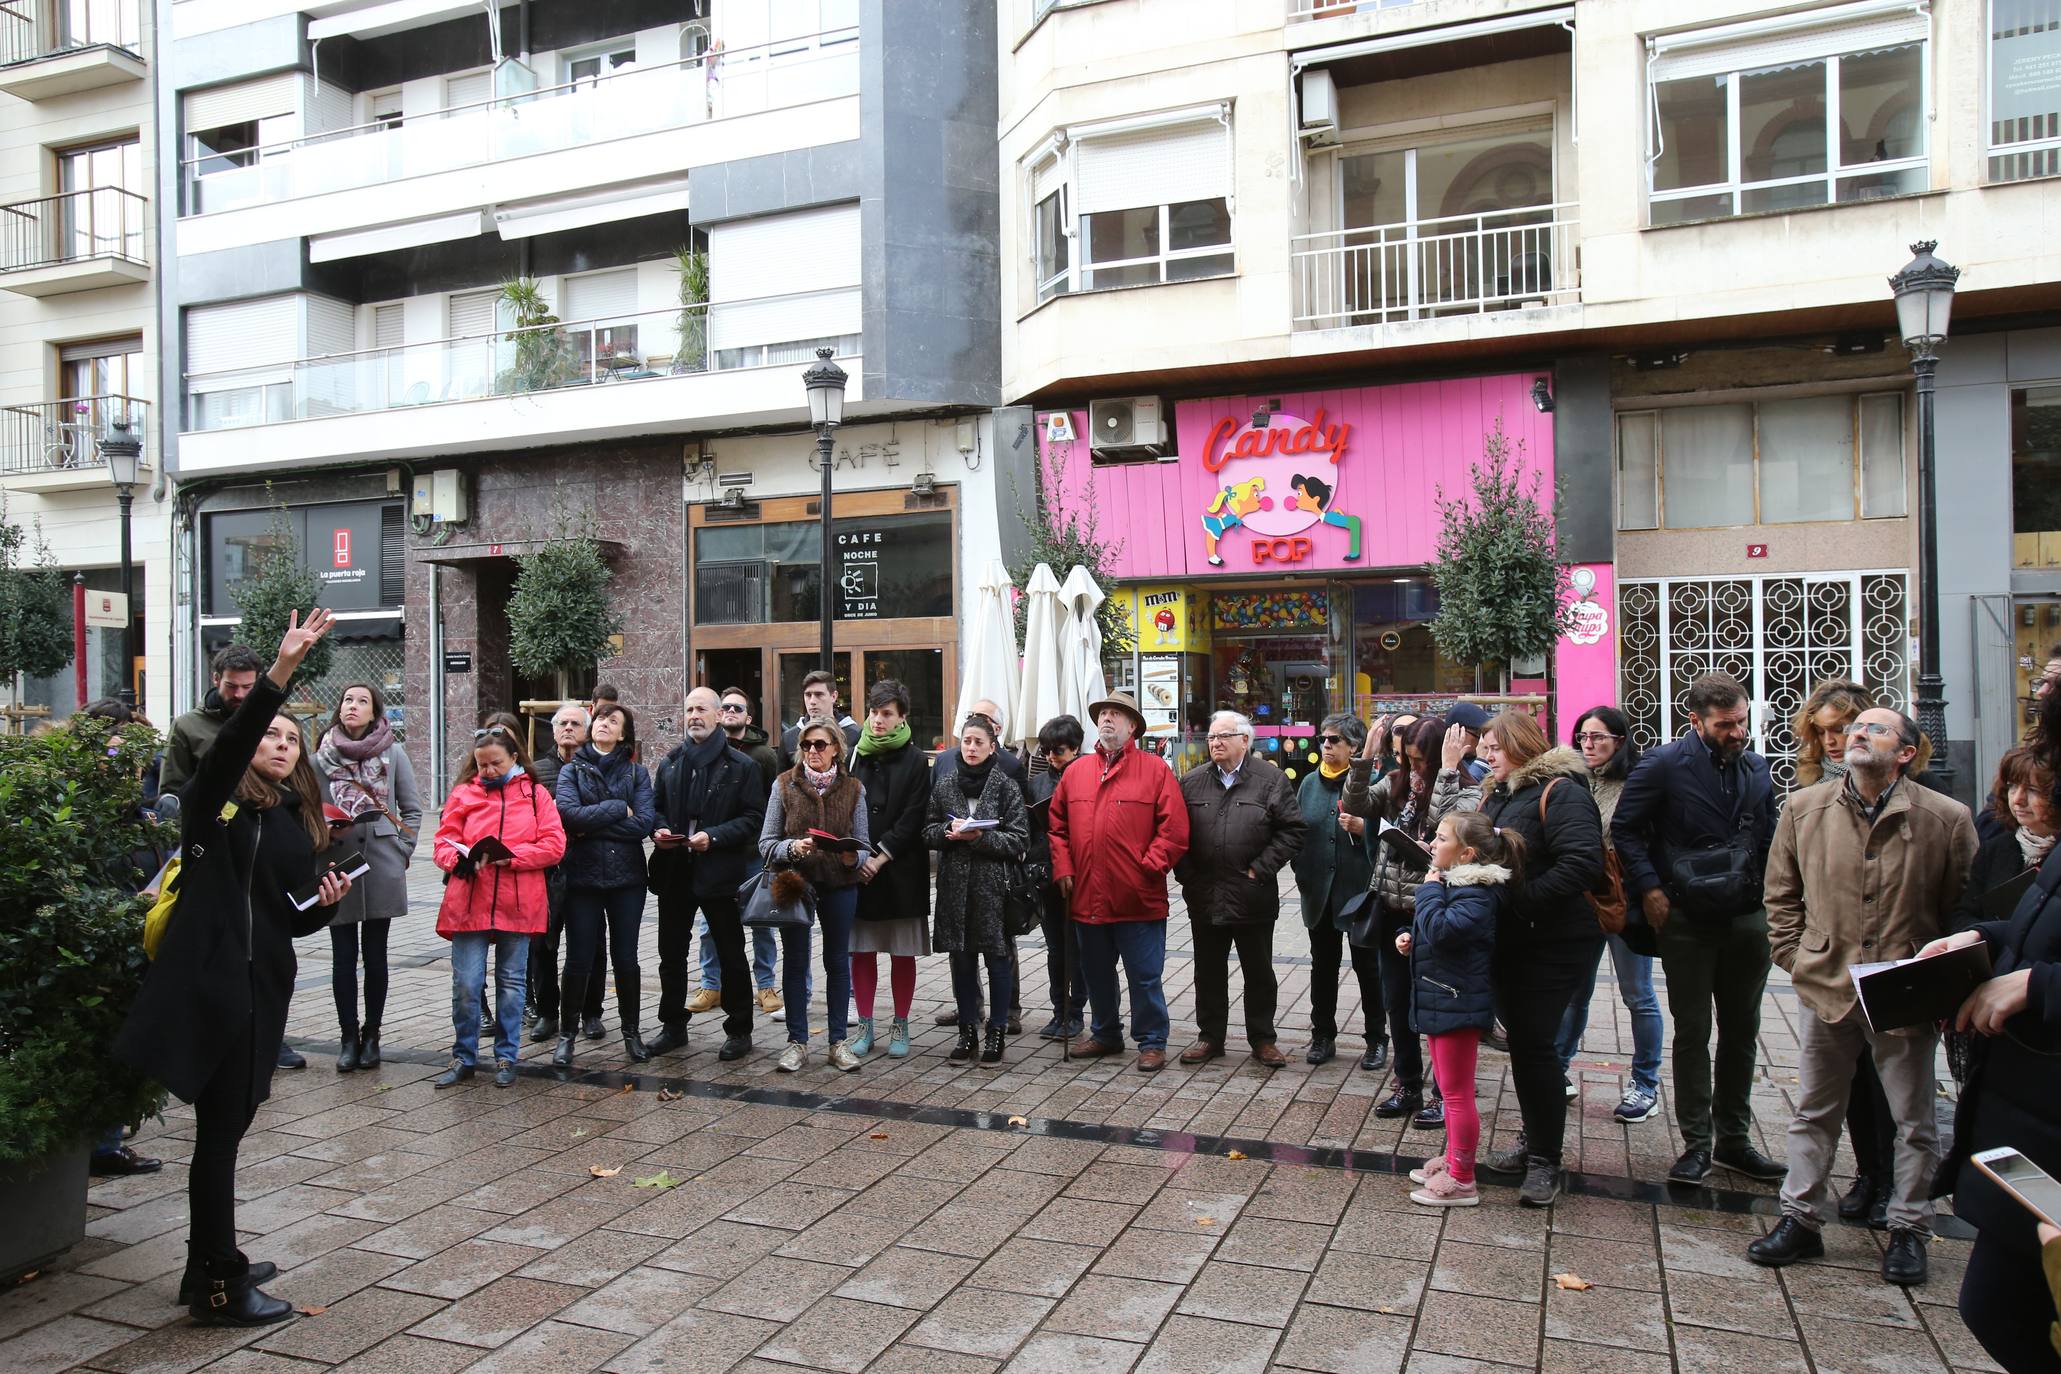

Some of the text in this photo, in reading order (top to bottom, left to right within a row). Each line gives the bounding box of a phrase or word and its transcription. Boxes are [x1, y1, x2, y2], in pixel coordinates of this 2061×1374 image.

[1202, 408, 1351, 474] Candy
[838, 533, 882, 544] CAFE
[843, 550, 878, 560] NOCHE
[1251, 537, 1312, 564] POP
[1752, 546, 1761, 556] 9
[329, 569, 351, 579] puerta
[352, 568, 366, 577] roja
[844, 602, 877, 611] Y DIA
